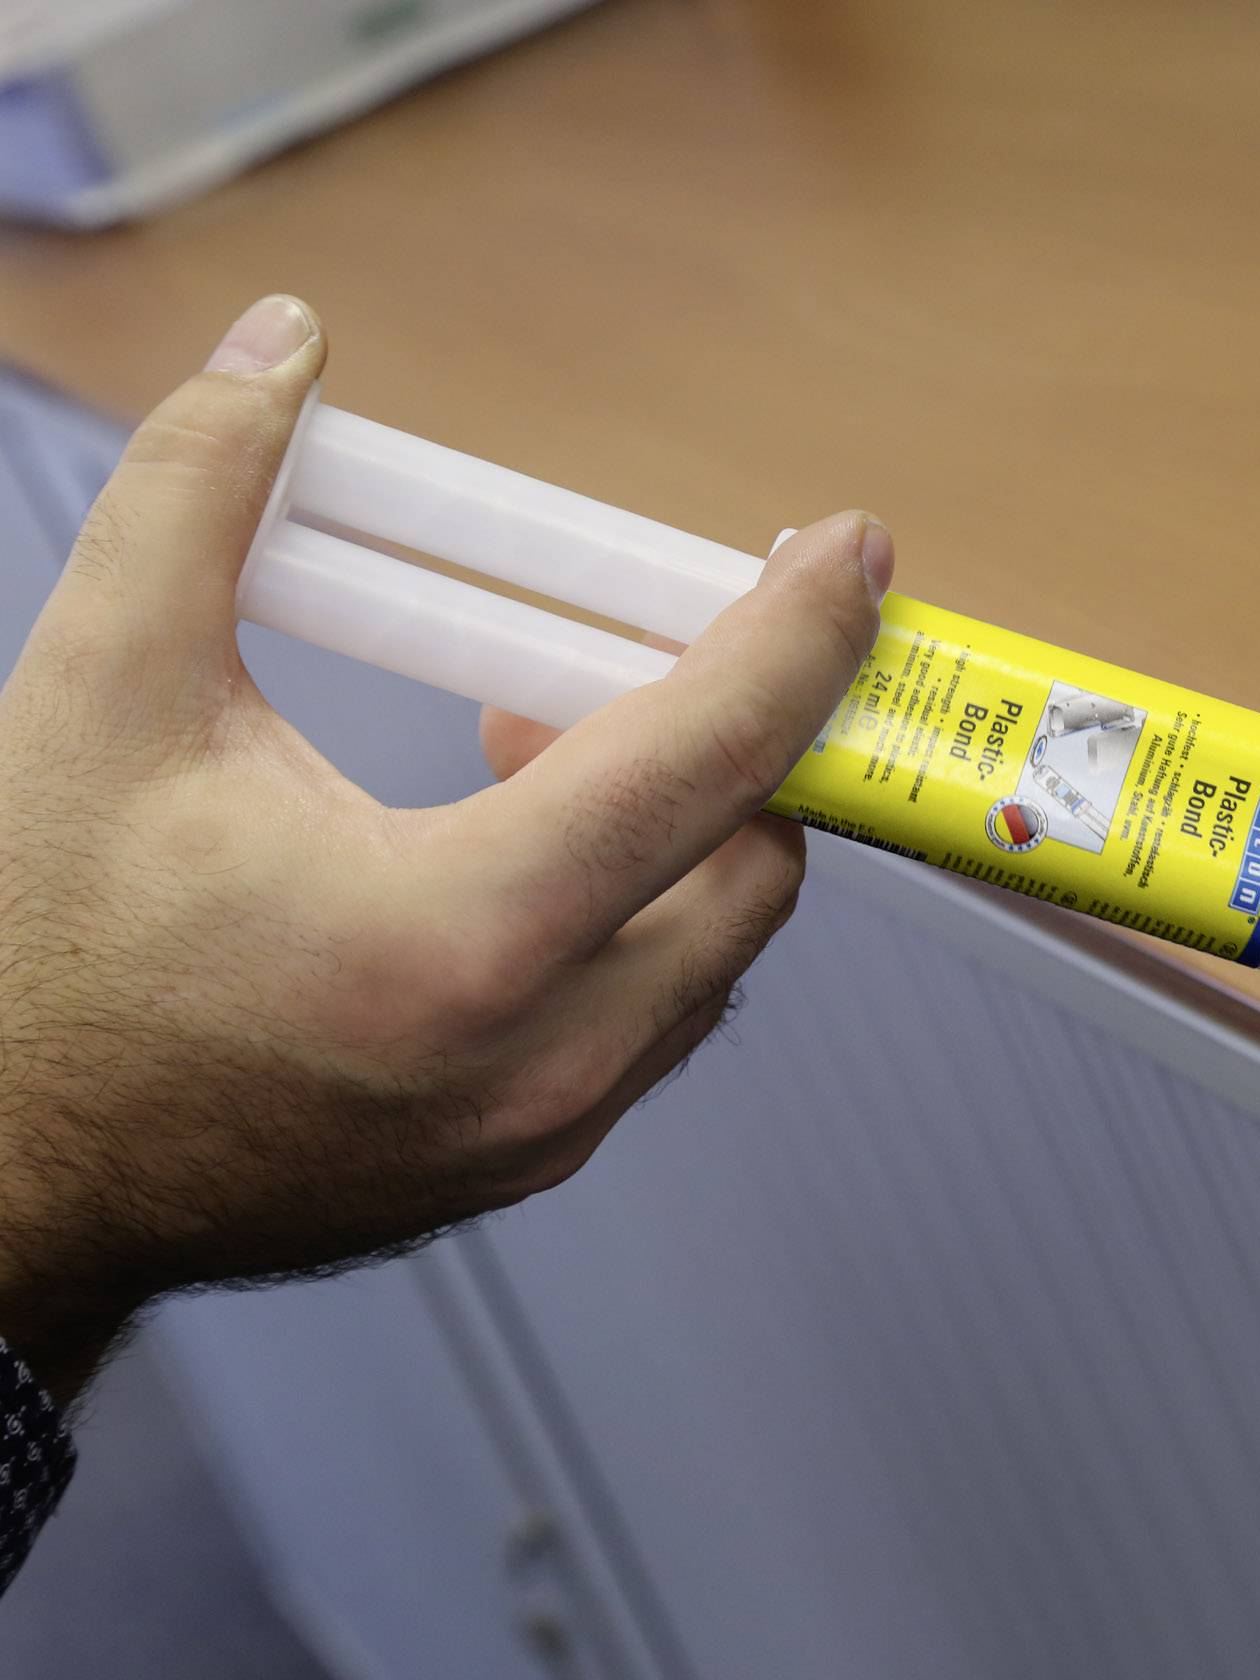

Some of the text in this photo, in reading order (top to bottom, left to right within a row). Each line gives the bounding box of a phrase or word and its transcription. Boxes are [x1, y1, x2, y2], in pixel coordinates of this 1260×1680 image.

[870, 670, 893, 692] 24
[948, 701, 989, 763] Bond
[977, 697, 1022, 781] Plastic-
[1147, 757, 1171, 796] Haftung
[1179, 779, 1217, 838] Bond
[1207, 775, 1251, 857] Plastic-
